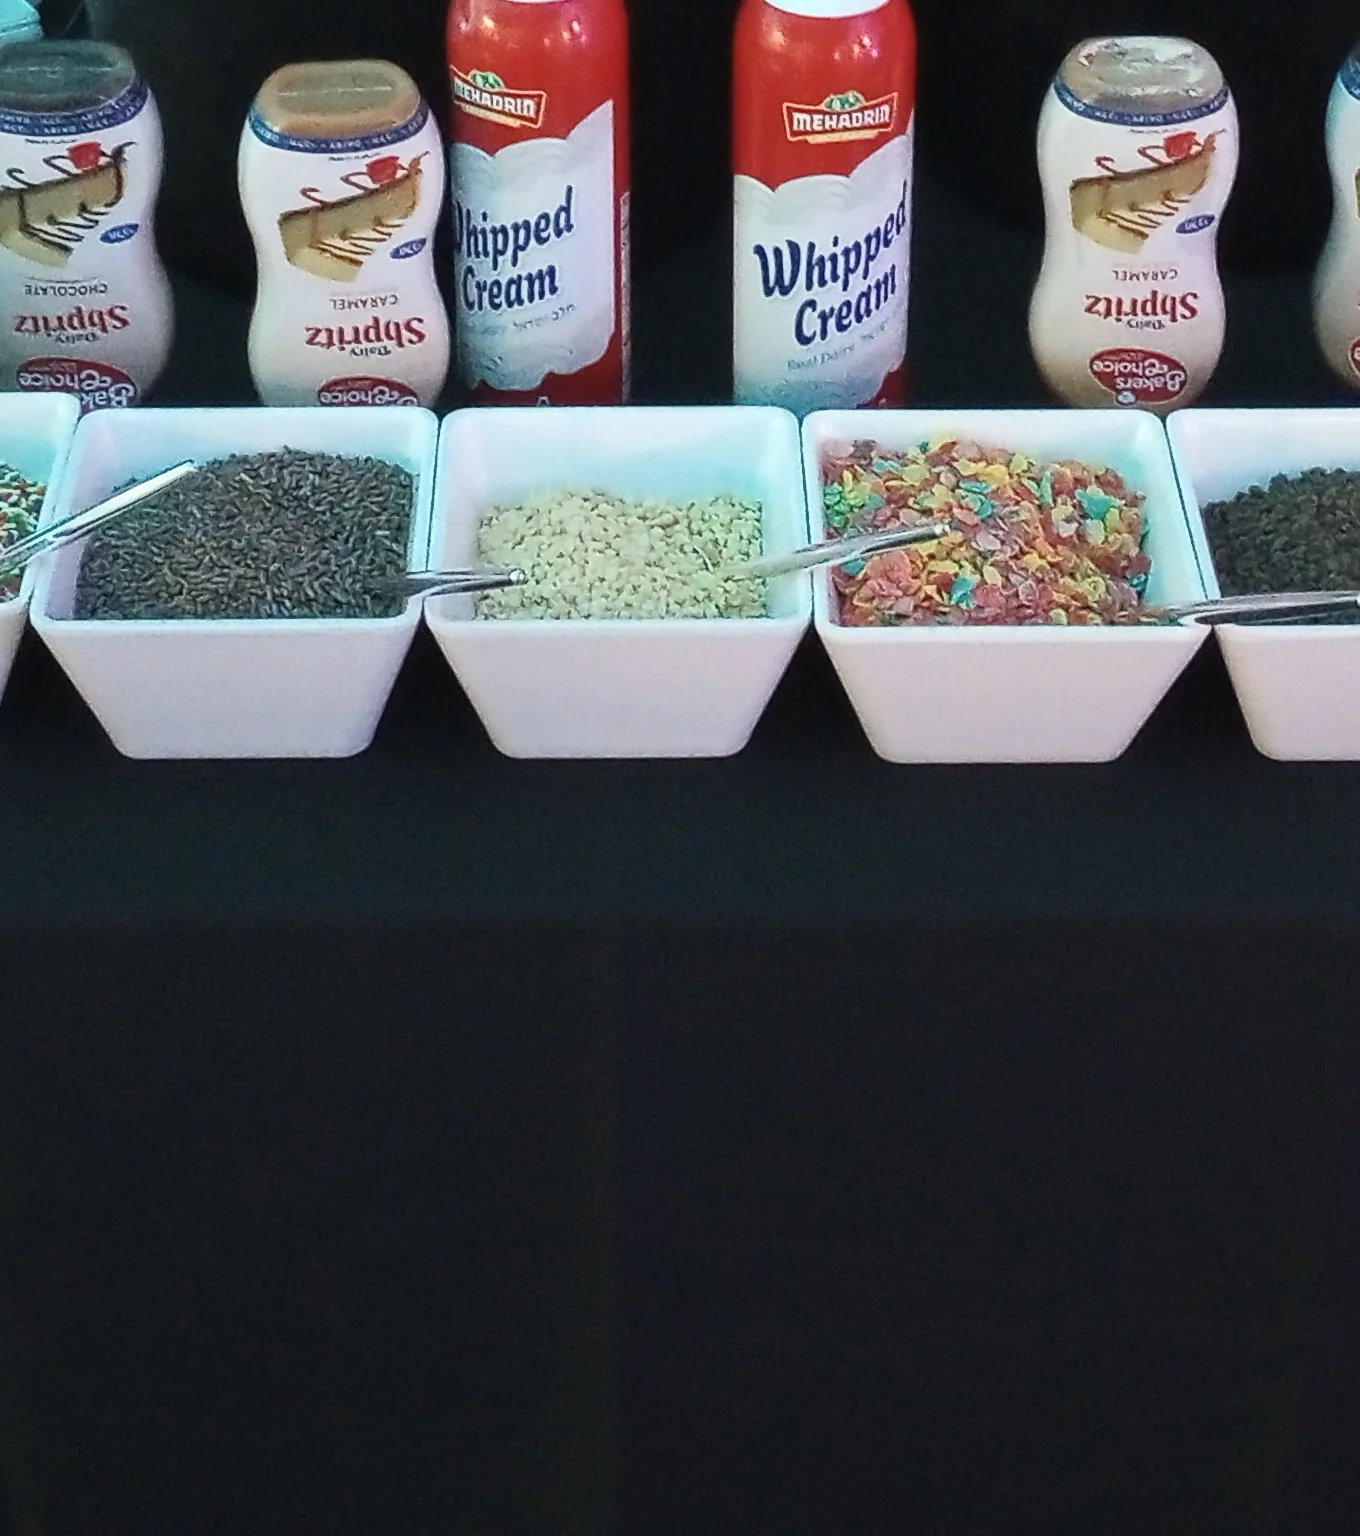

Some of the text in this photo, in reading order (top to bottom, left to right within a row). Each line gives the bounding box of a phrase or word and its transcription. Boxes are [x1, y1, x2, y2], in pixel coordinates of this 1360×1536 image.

[792, 104, 890, 132] MEHADRIN
[753, 178, 907, 297] Whipped
[462, 263, 559, 312] Cream
[1111, 268, 1178, 282] CARAMEL
[24, 283, 108, 297] CHOCOLATE
[329, 294, 398, 310] CARAMEL
[794, 263, 896, 346] Cream
[1083, 290, 1199, 322] Shpritz
[13, 304, 130, 337] Shpritz
[305, 316, 426, 352] Shpritz
[1092, 358, 1169, 376] Choice
[18, 370, 113, 391] Choice
[1115, 370, 1185, 392] Bakers
[80, 382, 135, 408] Bak
[320, 385, 400, 405] Choice
